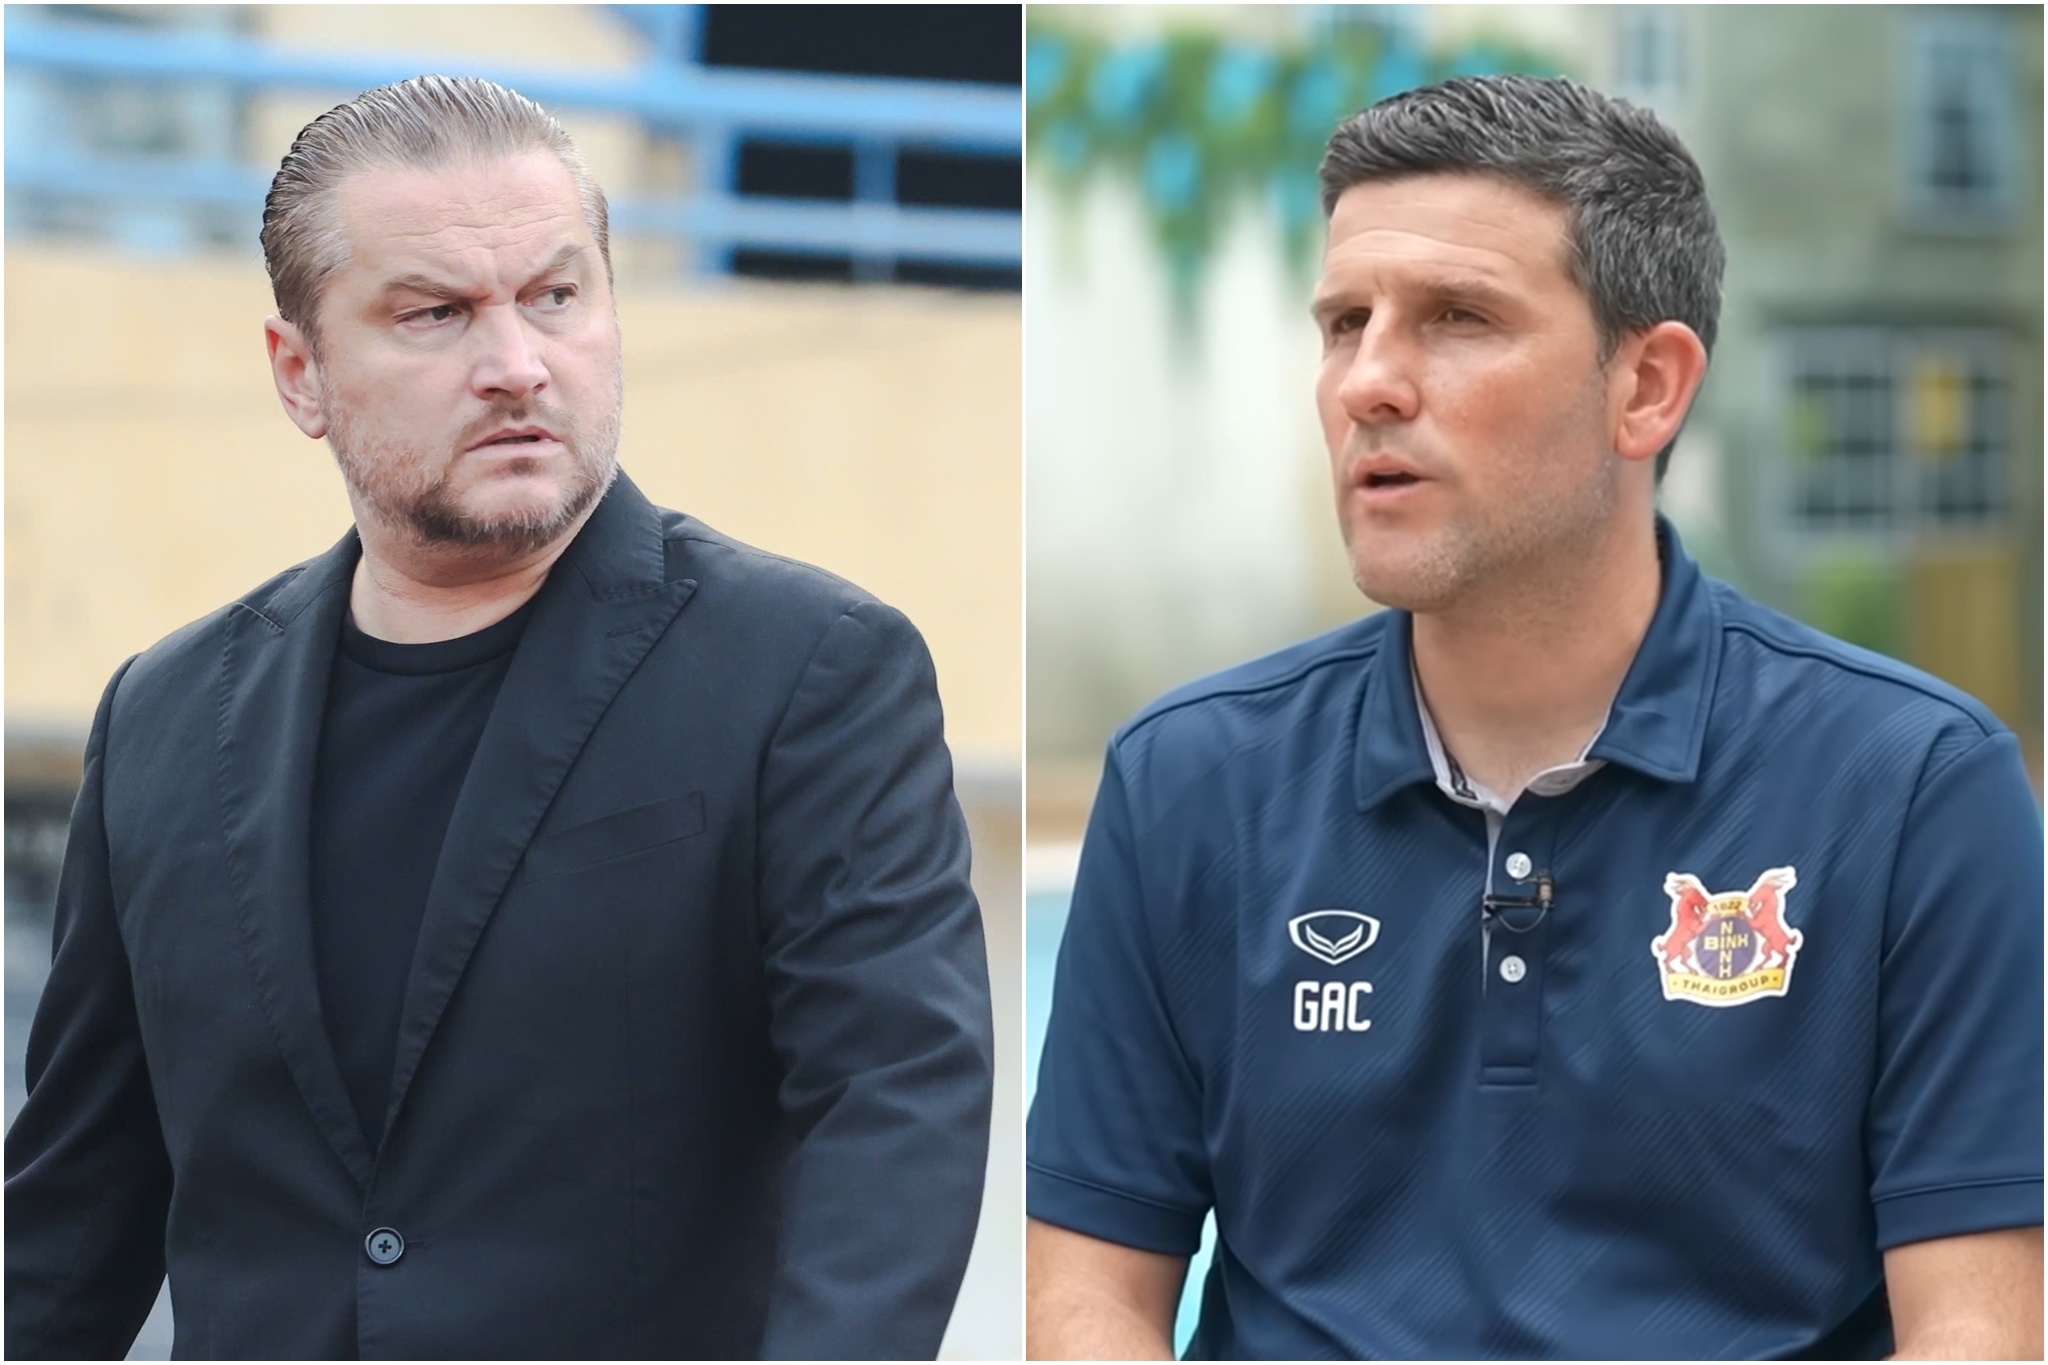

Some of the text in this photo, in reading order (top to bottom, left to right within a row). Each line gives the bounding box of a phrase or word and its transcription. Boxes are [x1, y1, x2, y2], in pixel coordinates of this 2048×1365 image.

[1704, 934, 1748, 950] BINH
[1682, 975, 1769, 996] THAIGROUP
[1294, 981, 1373, 1032] GAC
